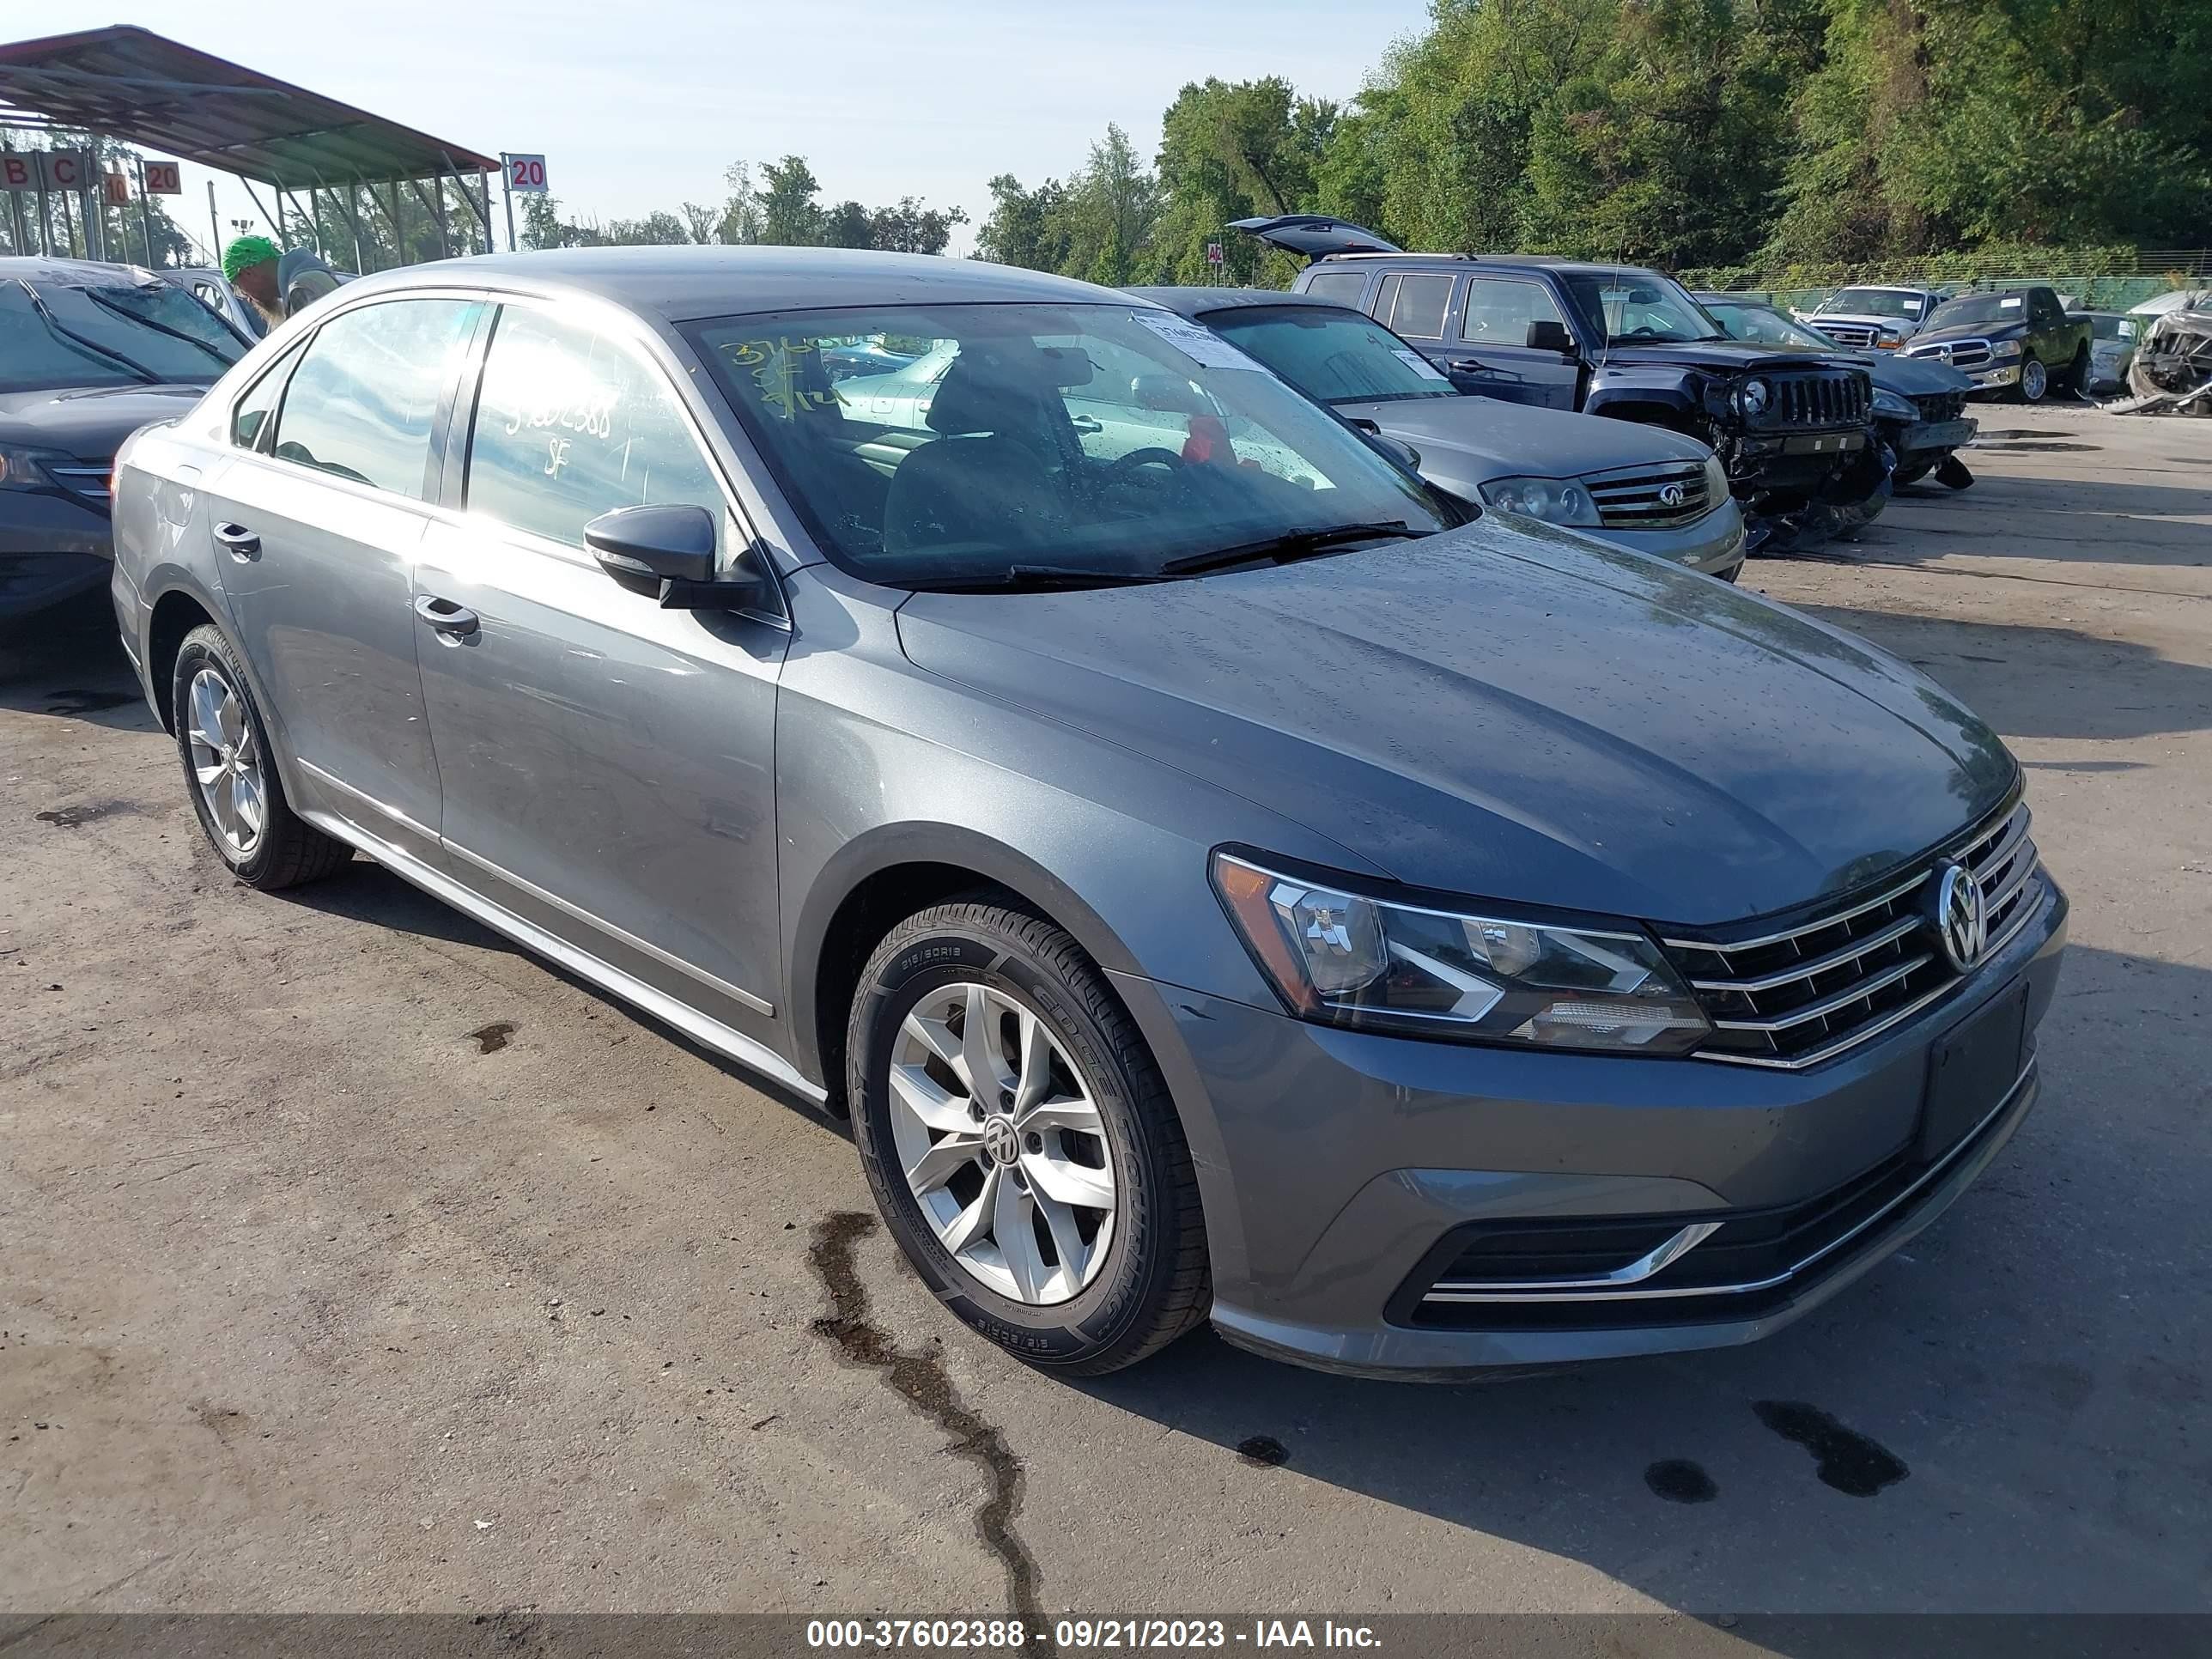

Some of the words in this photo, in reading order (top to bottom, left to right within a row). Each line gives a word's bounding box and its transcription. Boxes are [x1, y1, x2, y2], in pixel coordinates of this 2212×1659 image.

[4, 158, 28, 185] B
[54, 159, 76, 185] C
[149, 166, 178, 189] 20
[513, 160, 544, 185] 20
[106, 179, 128, 202] 10
[1032, 985, 1118, 1098] EDGE
[1106, 1117, 1148, 1318] TOURING
